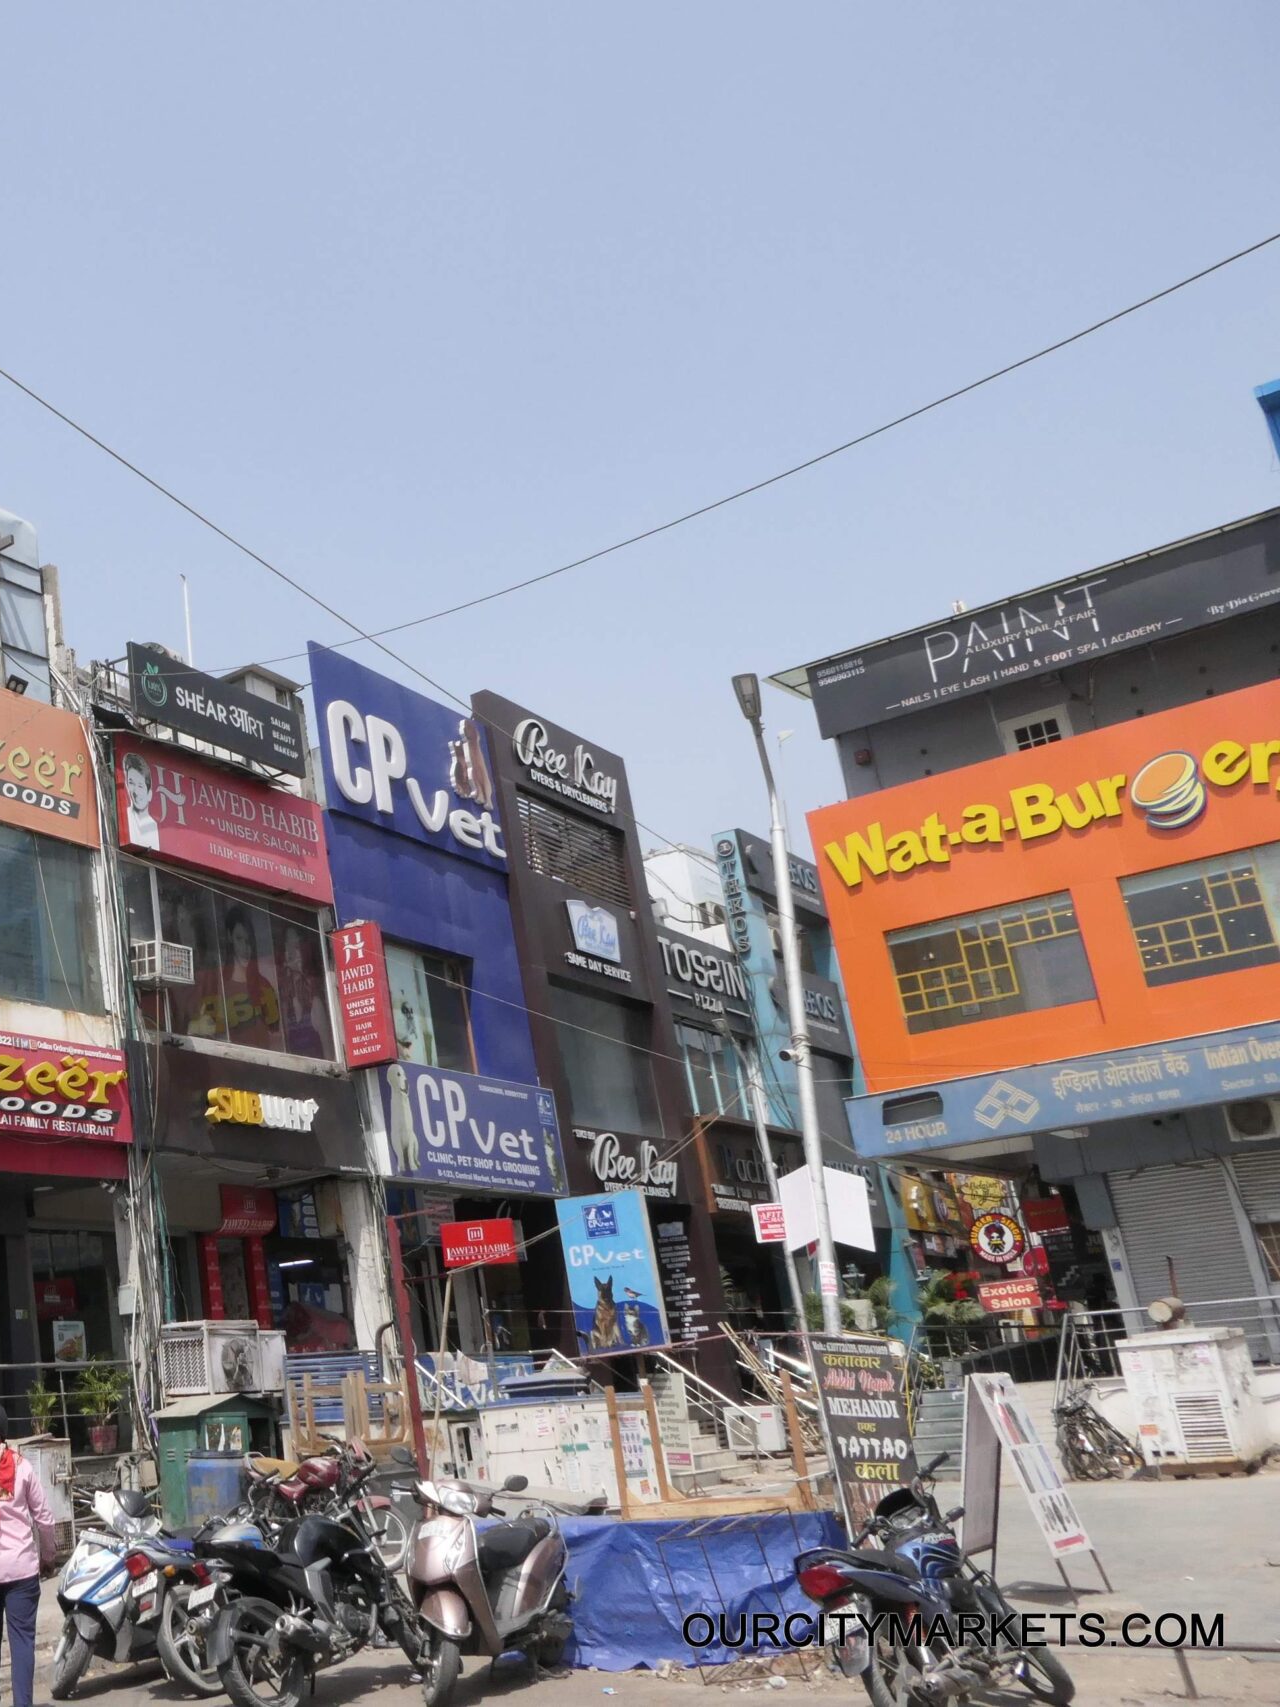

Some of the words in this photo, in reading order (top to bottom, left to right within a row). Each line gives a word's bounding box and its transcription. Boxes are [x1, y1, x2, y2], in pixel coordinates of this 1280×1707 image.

[923, 578, 1107, 683] PAINT
[965, 646, 975, 655] A
[975, 630, 1021, 654] LUXURY
[1025, 621, 1054, 638] NAIL
[1053, 608, 1097, 630] AFFAIR
[900, 690, 932, 708] NAILS
[940, 683, 961, 696] EYE
[962, 675, 991, 692] LASH
[999, 661, 1030, 680] HAND
[1033, 658, 1042, 668] &
[1044, 648, 1073, 665] FOOT
[1076, 641, 1100, 656] SPA
[1110, 620, 1163, 646] ACADEMY
[176, 686, 227, 725] SHEAR
[270, 716, 291, 731] SALON
[272, 731, 296, 745] BEAUTY
[274, 743, 299, 760] MAKEUP
[512, 718, 568, 779] Bee
[573, 744, 617, 814] Kay
[530, 768, 554, 789] DYERS
[191, 778, 256, 821] JAWED
[259, 803, 320, 843] HABIB
[218, 818, 260, 843] UNISEX
[263, 831, 300, 857] SALON
[209, 842, 234, 859] HAIR
[238, 847, 274, 872] BEAUTY
[279, 862, 316, 885] MAKEUP
[340, 964, 373, 984] JAWED
[566, 951, 587, 969] SAME
[588, 958, 603, 974] DAY
[603, 962, 632, 982] SERVICE
[343, 977, 374, 995] HABIB
[346, 997, 375, 1010] UNISEX
[349, 1006, 375, 1017] SALON
[355, 1021, 372, 1031] HAIR
[352, 1032, 378, 1044] BEAUTY
[352, 1044, 381, 1056] MAKEUP
[1205, 1045, 1249, 1069] Indian
[205, 1087, 320, 1132] SUBWAY
[14, 1115, 49, 1130] FAMILY
[52, 1120, 115, 1137] RESTAURANT
[885, 1129, 902, 1144] 24
[905, 1121, 947, 1140] HOUR
[457, 1155, 472, 1167] PET
[473, 1158, 494, 1169] SHOP
[495, 1161, 501, 1171] &
[503, 1162, 540, 1176] GROOMING
[971, 1216, 993, 1244] BURGER
[446, 1245, 478, 1260] JAWED
[480, 1243, 510, 1253] HABIB
[980, 1282, 1035, 1298] Exotica
[991, 1295, 1031, 1309] Salon
[823, 1354, 881, 1369] कलाकार
[826, 1397, 900, 1418] MEHANDI
[855, 1462, 900, 1481] कला
